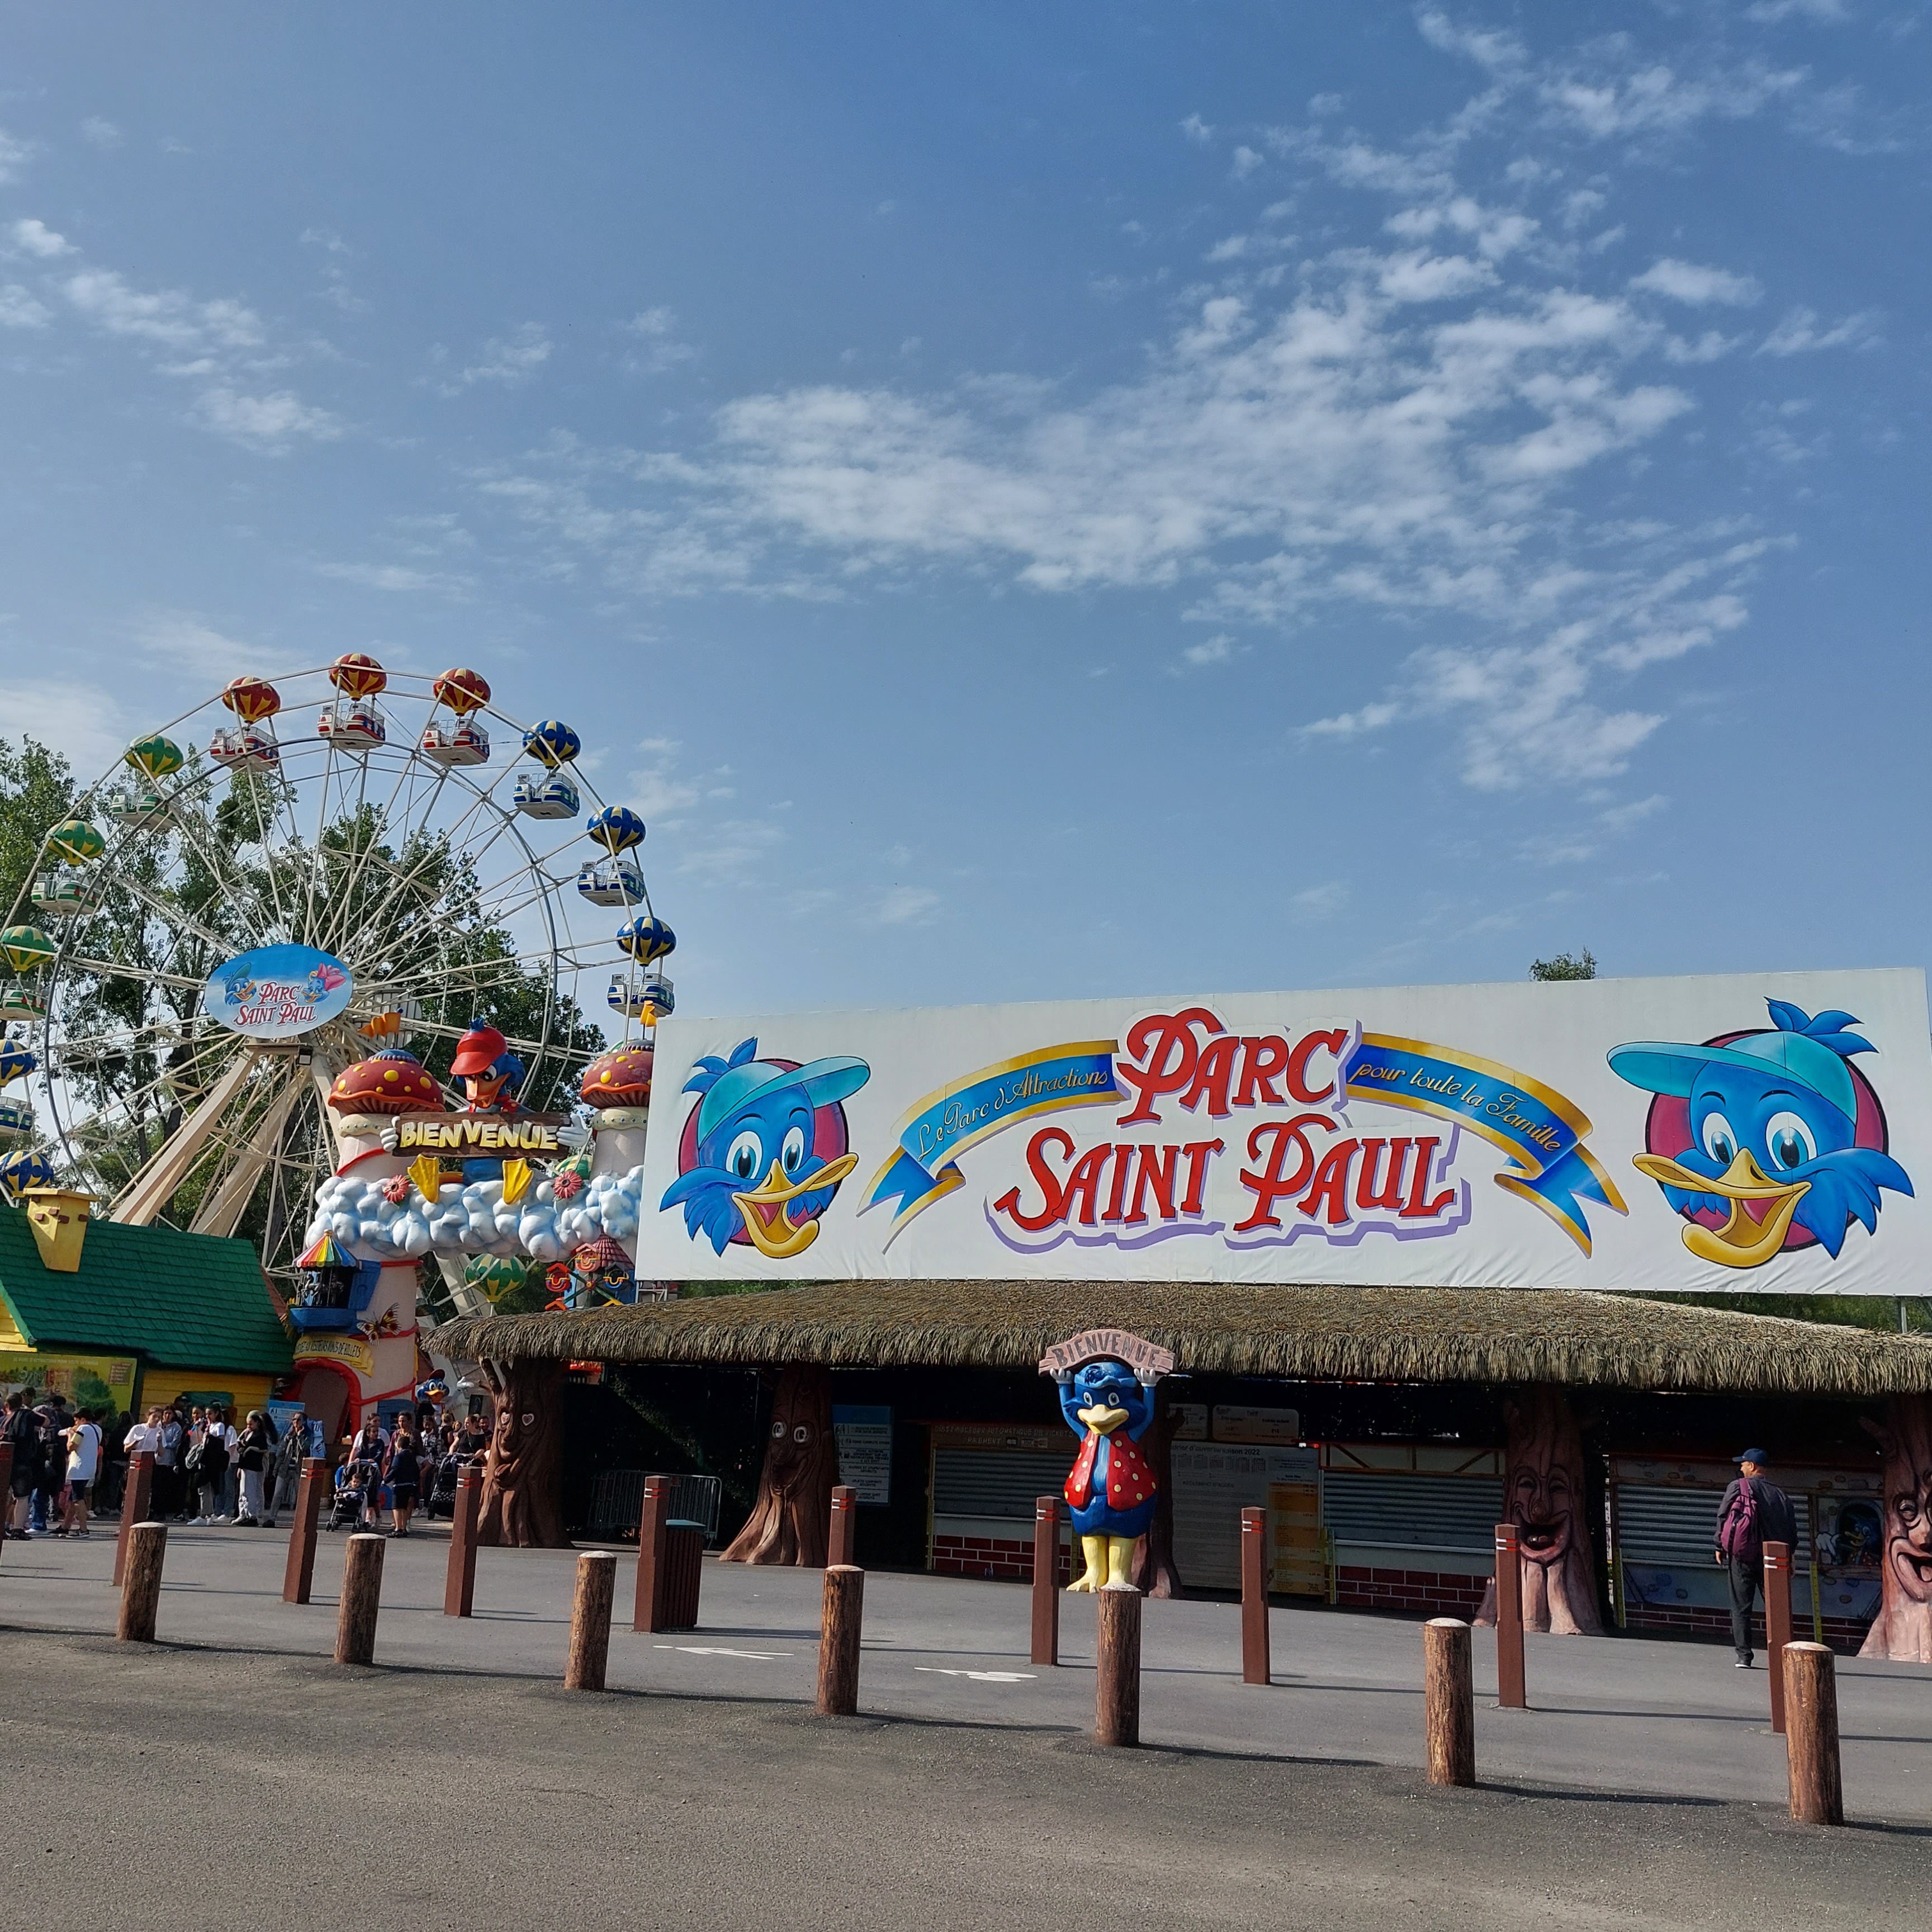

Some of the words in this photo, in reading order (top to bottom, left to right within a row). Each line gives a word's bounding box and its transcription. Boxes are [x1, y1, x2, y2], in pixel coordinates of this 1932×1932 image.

[233, 1006, 277, 1025] SAINT
[277, 1003, 319, 1025] PAUL
[257, 982, 302, 1005] PARC
[1117, 1007, 1348, 1125] PARC
[400, 1119, 559, 1150] BIENVENUE
[918, 1124, 944, 1161] Le
[944, 1102, 989, 1134] Parc
[994, 1068, 1109, 1111] d'Attractions
[1347, 1063, 1407, 1083] pour
[1409, 1067, 1462, 1095] toute
[1460, 1083, 1484, 1107] la
[1486, 1093, 1561, 1152] Famille
[995, 1127, 1224, 1231] SAINT
[1233, 1114, 1454, 1231] PAUL
[1052, 1332, 1160, 1368] BIENVENUE
